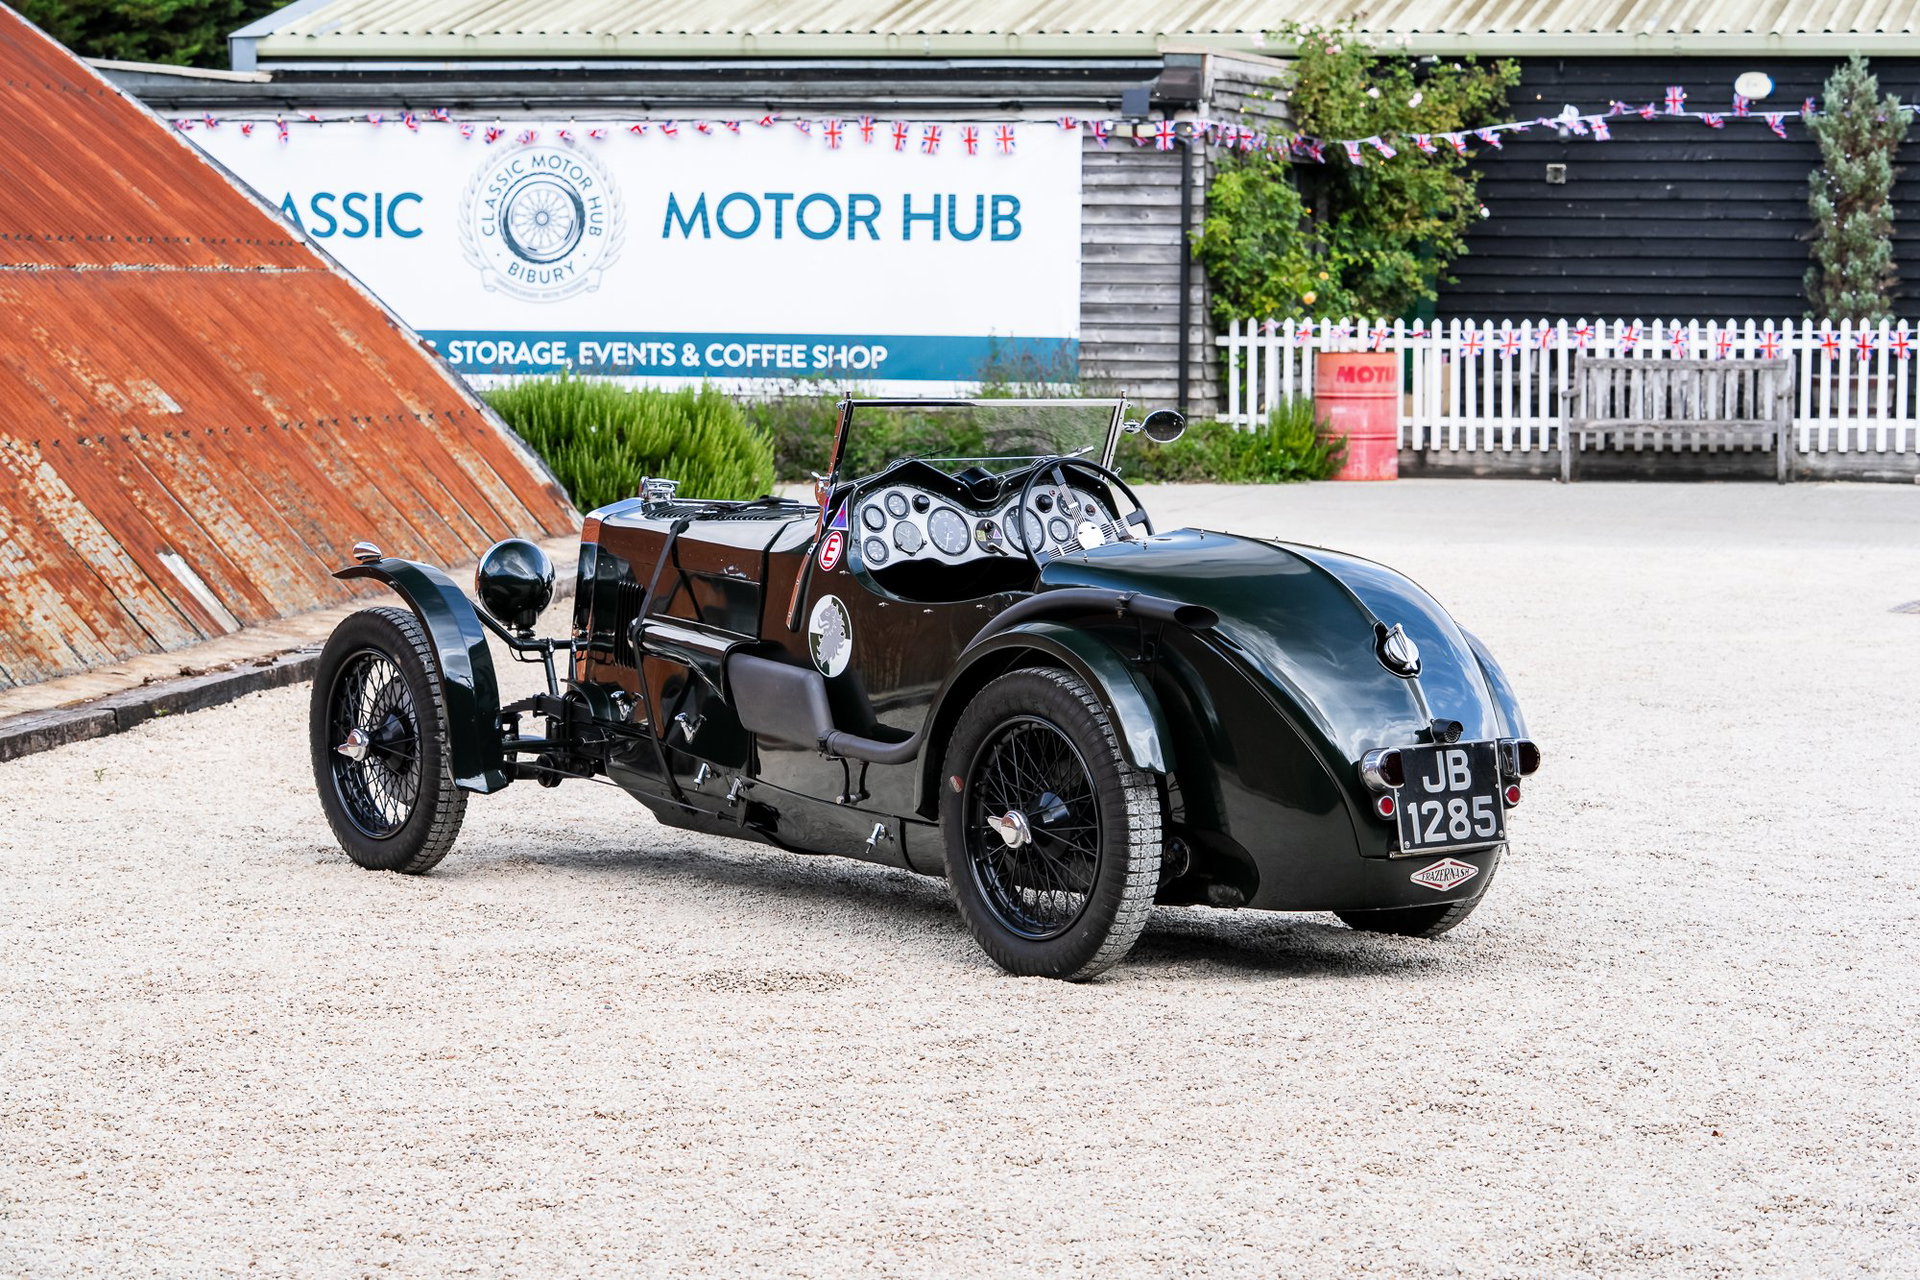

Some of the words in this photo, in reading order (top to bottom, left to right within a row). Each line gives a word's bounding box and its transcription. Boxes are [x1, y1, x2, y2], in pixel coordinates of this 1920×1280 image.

[481, 159, 524, 237] CLASSIC
[531, 154, 594, 192] MOTOR
[588, 196, 604, 238] HUB
[661, 191, 882, 241] MOTOR
[902, 193, 1022, 242] HUB
[507, 261, 576, 284] BIBURY
[448, 340, 573, 370] STORAGE,
[578, 340, 677, 367] EVENTS
[681, 342, 701, 368] &
[704, 342, 808, 369] COFFEE
[812, 344, 888, 370] SHOP
[823, 538, 839, 562] E
[1422, 749, 1472, 793] JB
[1407, 795, 1497, 844] 1285
